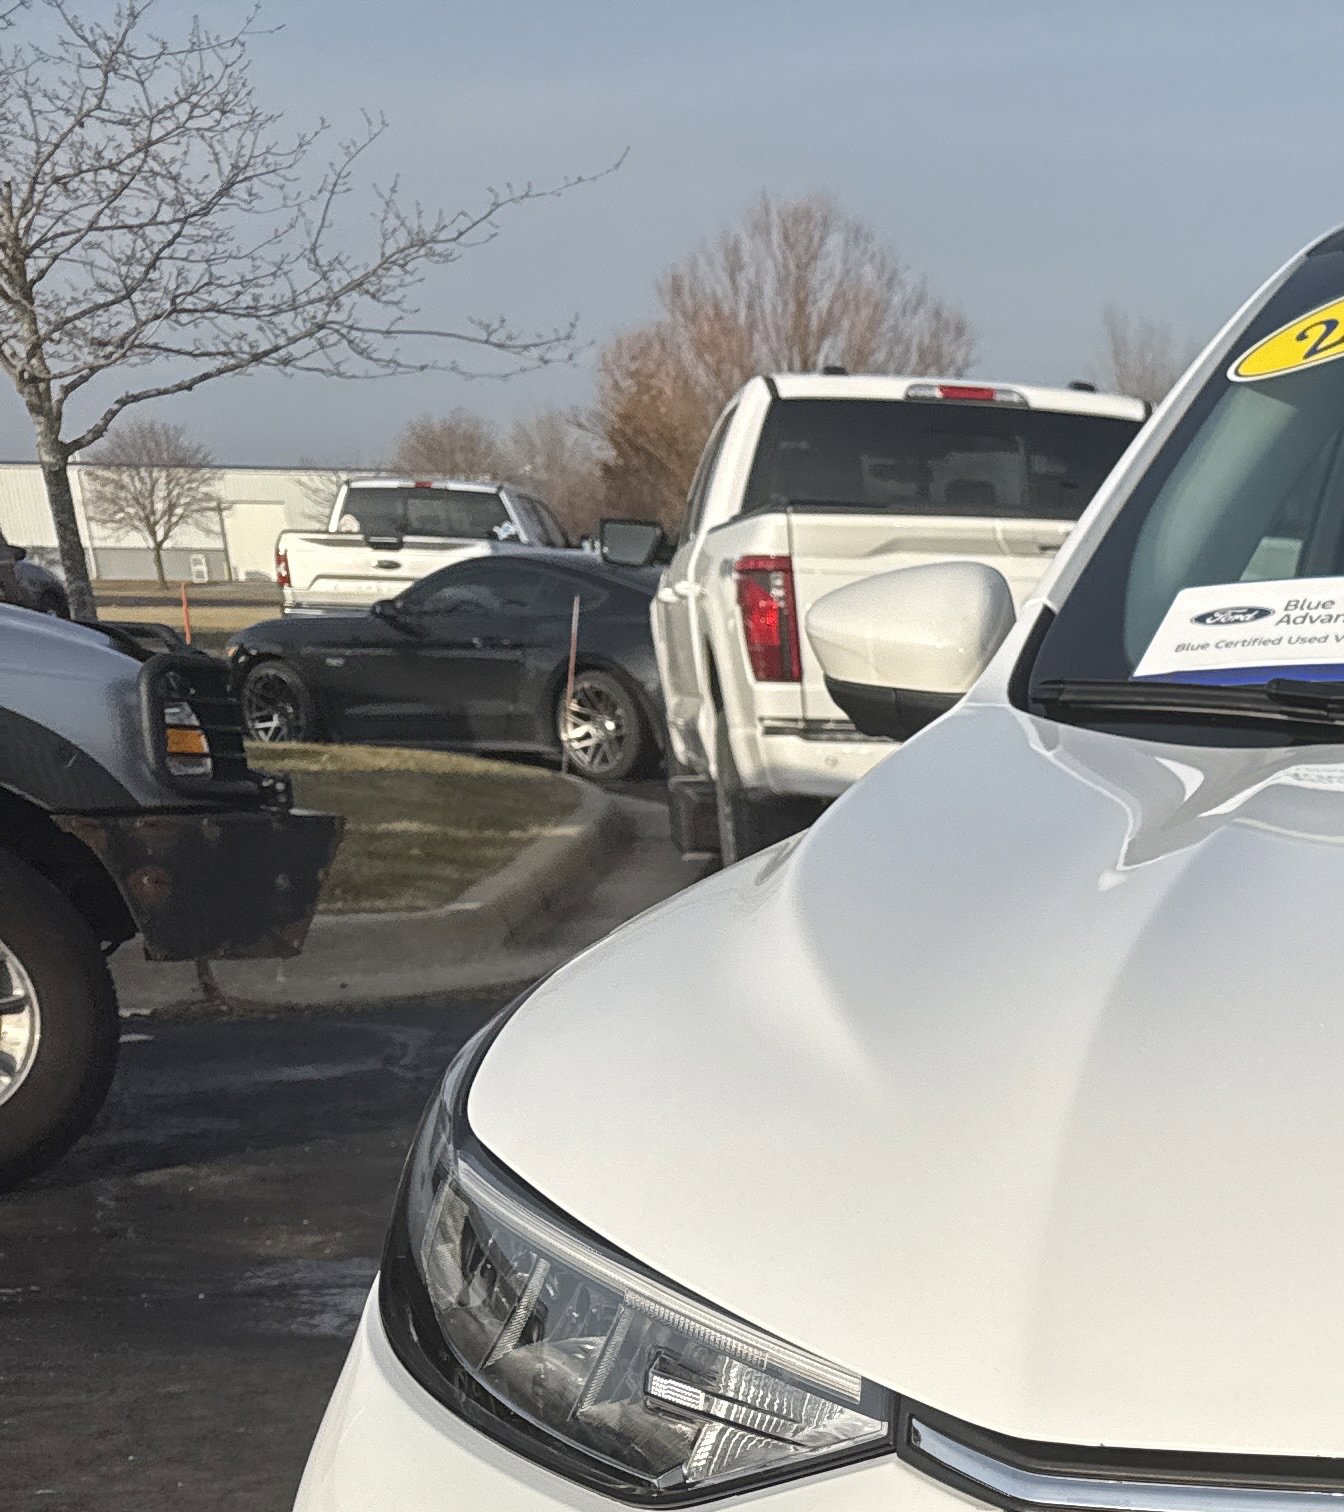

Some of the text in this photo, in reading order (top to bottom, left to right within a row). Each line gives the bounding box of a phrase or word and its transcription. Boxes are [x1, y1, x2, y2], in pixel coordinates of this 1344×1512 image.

[1283, 598, 1335, 612] Blue
[1205, 608, 1260, 624] Ford
[1174, 641, 1211, 653] Blue
[1214, 635, 1283, 649] Certified
[1287, 634, 1329, 646] Used
